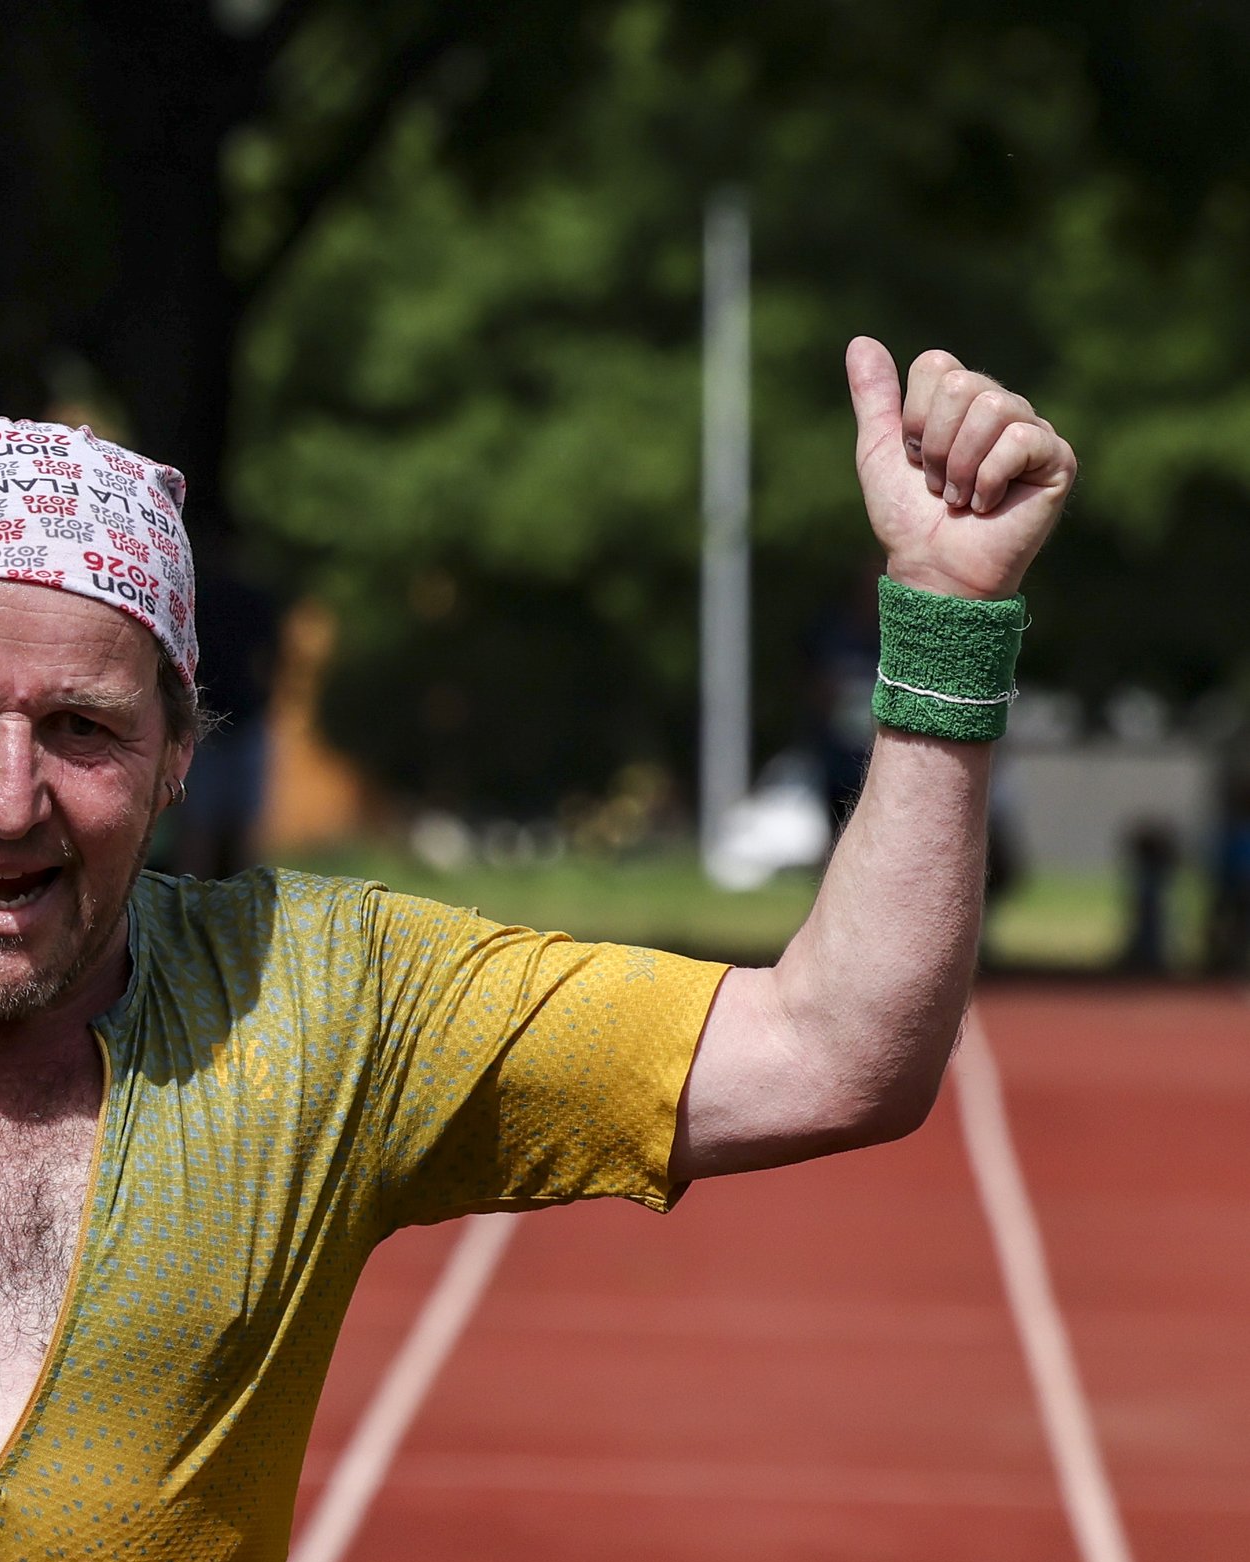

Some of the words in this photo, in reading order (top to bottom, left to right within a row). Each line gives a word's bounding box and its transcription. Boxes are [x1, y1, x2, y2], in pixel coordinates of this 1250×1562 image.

[32, 459, 83, 473] 2026
[103, 454, 145, 472] 2026
[109, 462, 145, 480] sion
[38, 467, 82, 480] sion
[93, 468, 138, 489] 2026
[99, 478, 138, 497] sion
[22, 494, 78, 507] 2026
[87, 485, 130, 514] LA
[28, 504, 76, 518] sion
[89, 504, 136, 528] 2026
[40, 517, 95, 533] 2026
[95, 514, 135, 536] sion
[45, 528, 94, 544] sion
[107, 528, 150, 556] 2026
[112, 540, 149, 564] sion
[83, 551, 159, 599] 2026
[92, 572, 156, 615] sion
